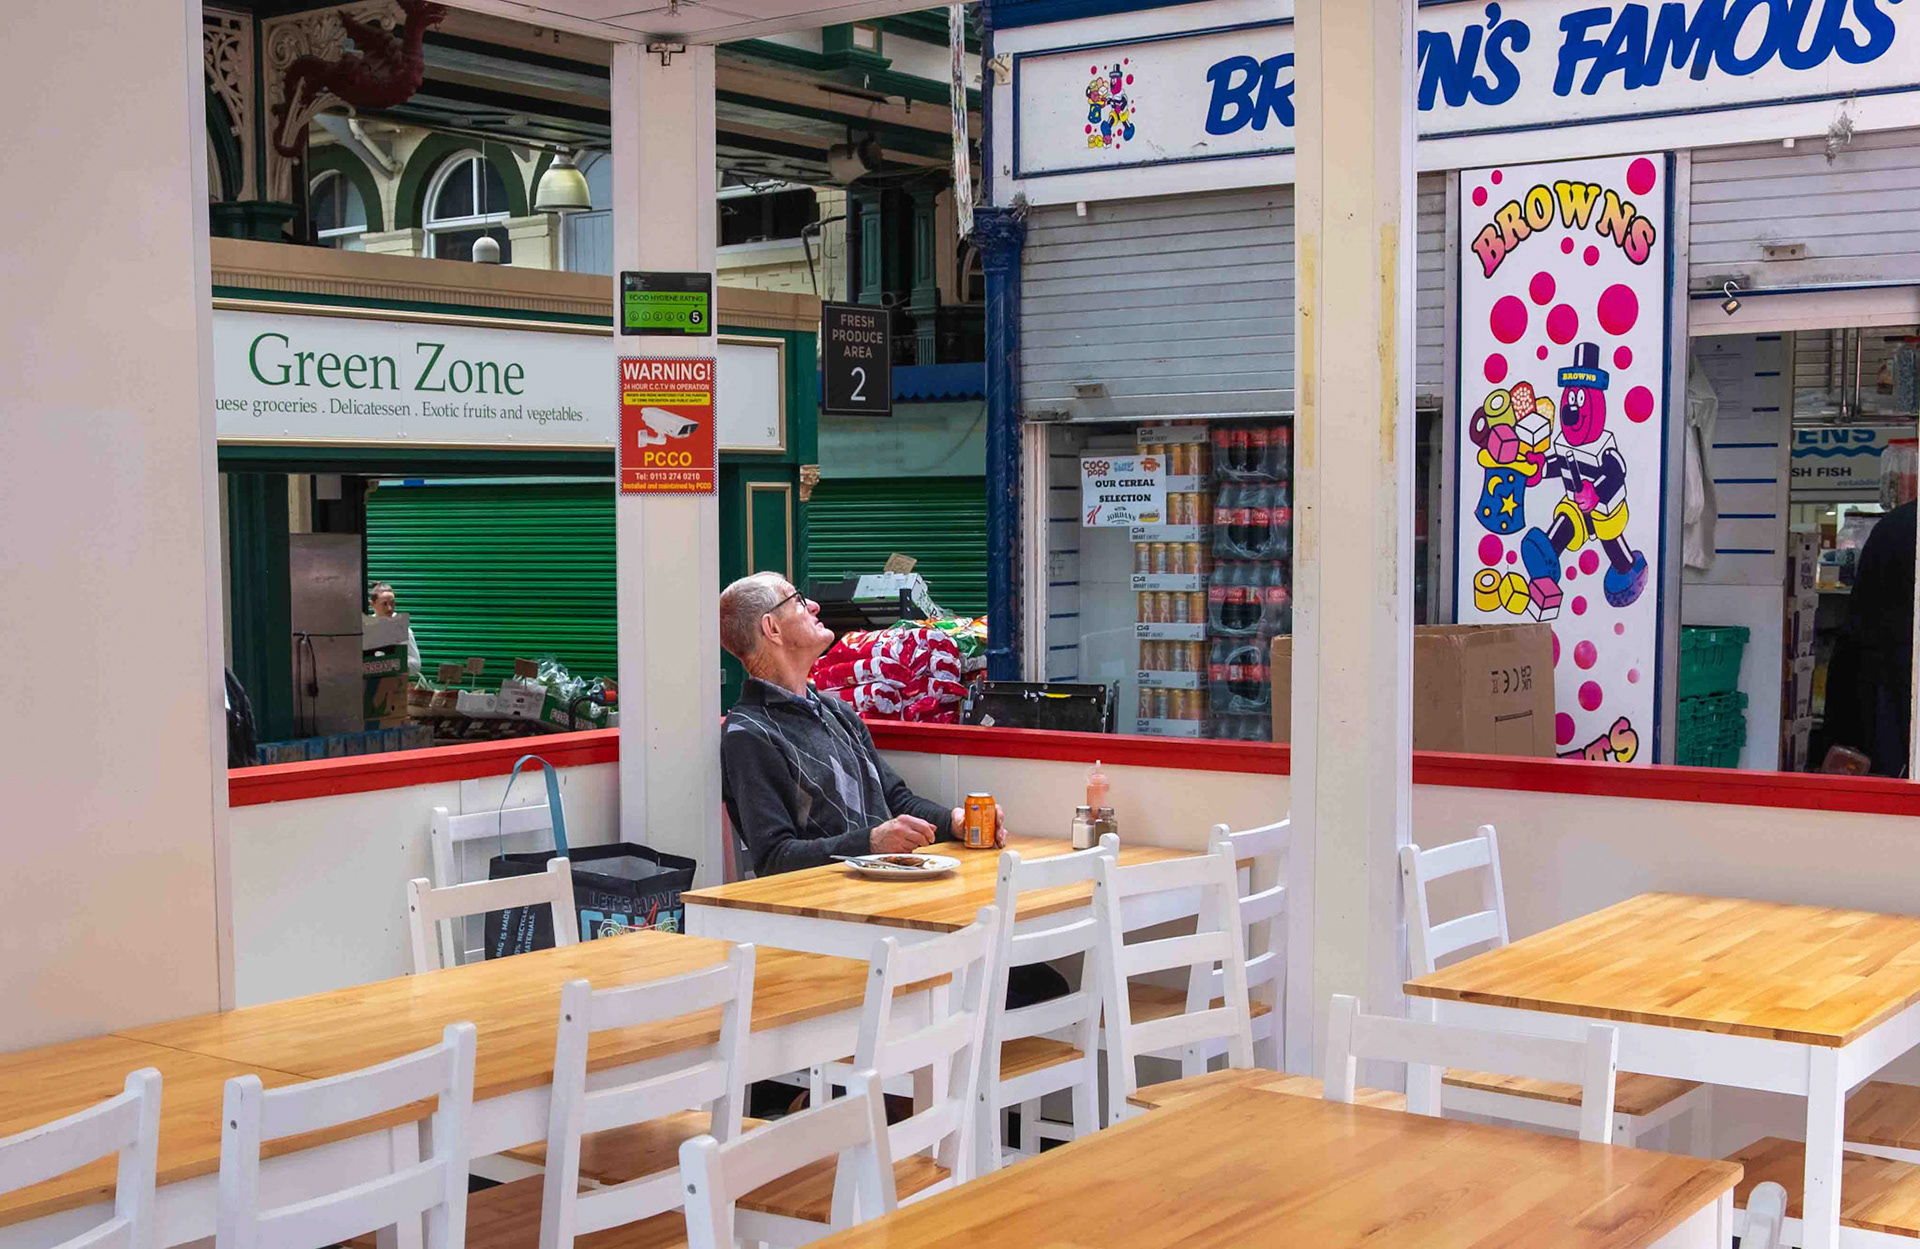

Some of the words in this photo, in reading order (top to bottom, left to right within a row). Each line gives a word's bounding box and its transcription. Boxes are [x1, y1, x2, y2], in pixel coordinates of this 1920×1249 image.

[1552, 0, 1902, 97] FAMOUS
[1471, 180, 1656, 279] BROWNS
[692, 312, 699, 323] 5
[841, 314, 875, 328] FRESH
[832, 329, 883, 344] PRODUCE
[844, 345, 873, 358] AREA
[249, 332, 400, 391] Green
[414, 342, 525, 396] Zone
[623, 363, 711, 381] WARNING!
[1562, 373, 1596, 382] BROWNS
[851, 366, 866, 401] 2
[216, 398, 248, 412] uese
[253, 398, 318, 417] groceries
[330, 398, 411, 416] Delicatessen
[423, 401, 460, 417] Exotic
[463, 402, 497, 419] fruits
[500, 404, 523, 420] and
[527, 406, 583, 425] vegetables
[767, 427, 776, 437] 30
[644, 452, 692, 467] PCCO
[1817, 467, 1852, 477] FISH
[1095, 480, 1116, 488] OUR
[1119, 479, 1155, 487] CEREAL
[1099, 494, 1152, 503] SELECTION
[1087, 505, 1102, 525] K
[1107, 511, 1137, 521] JORDANS
[589, 891, 632, 914] LET'S
[634, 888, 683, 915] HAVE
[502, 909, 511, 930] MADE
